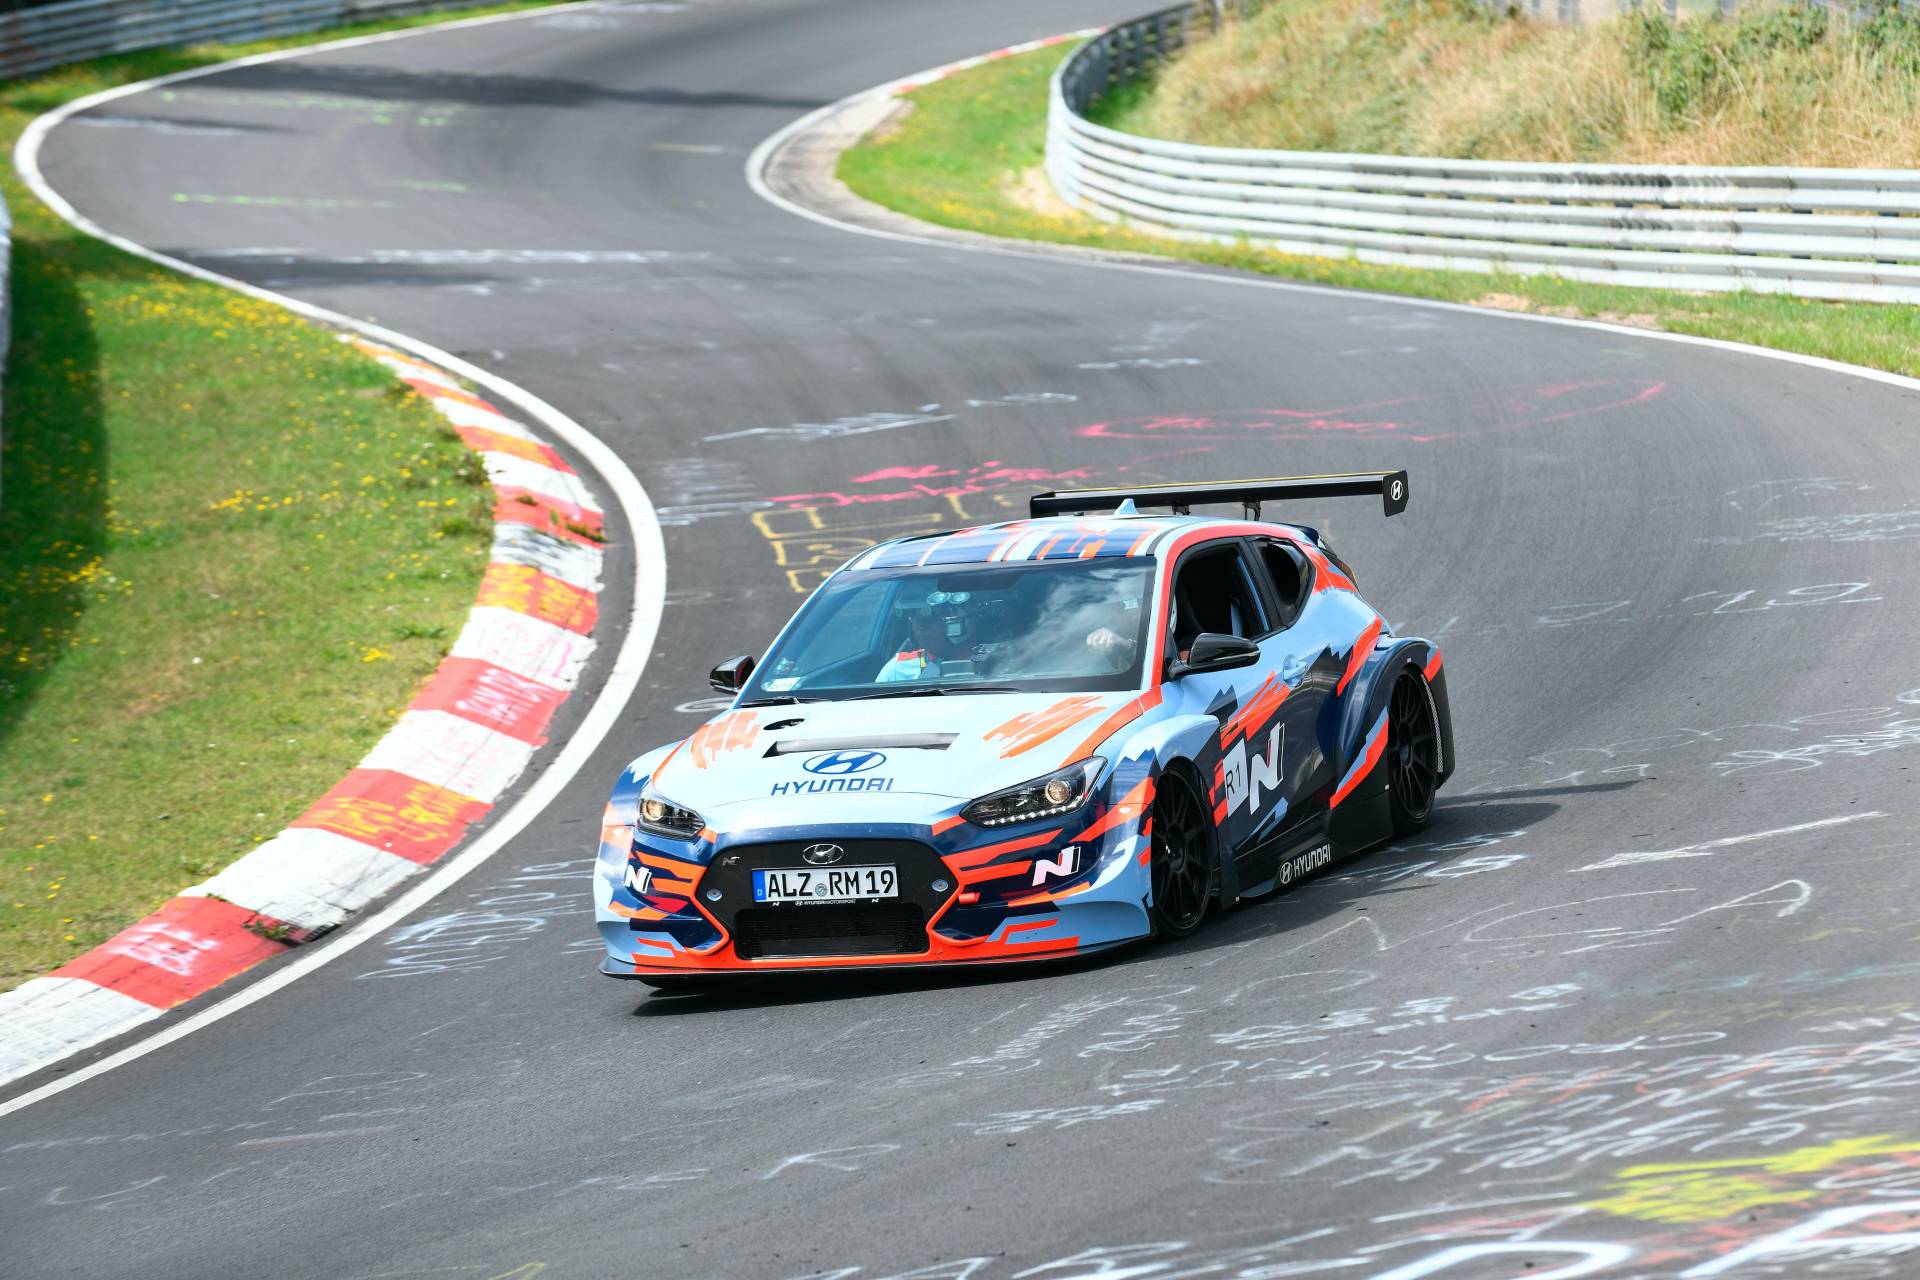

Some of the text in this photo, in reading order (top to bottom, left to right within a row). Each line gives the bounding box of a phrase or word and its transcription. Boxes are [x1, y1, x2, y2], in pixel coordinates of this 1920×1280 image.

[771, 777, 894, 796] HYUNDAI
[1225, 761, 1241, 800] R1
[1294, 843, 1331, 878] HYUNDAI
[768, 872, 813, 898] ALZ
